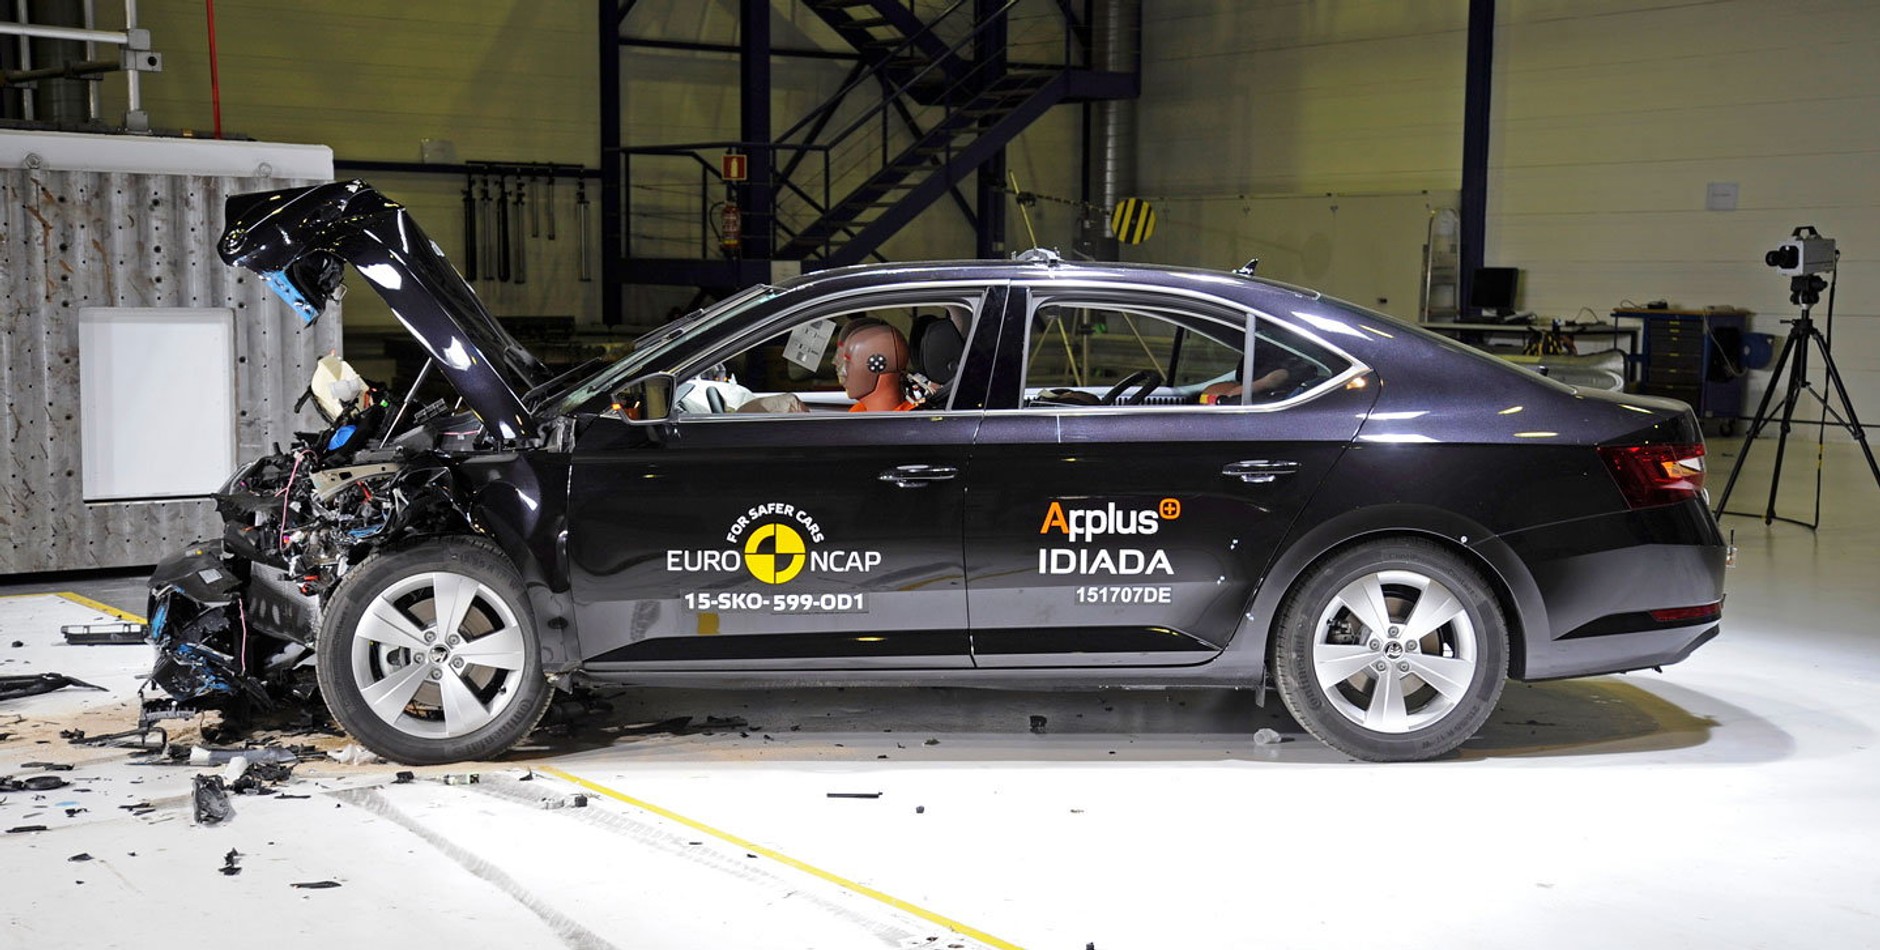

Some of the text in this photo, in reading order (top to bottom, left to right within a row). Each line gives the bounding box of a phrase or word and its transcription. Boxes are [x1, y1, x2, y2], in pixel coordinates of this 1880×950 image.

[726, 503, 825, 544] FOR SAFER CARS
[666, 550, 882, 572] EURO NCAP
[1038, 548, 1175, 575] IDIADA
[1076, 587, 1172, 603] 151707DE
